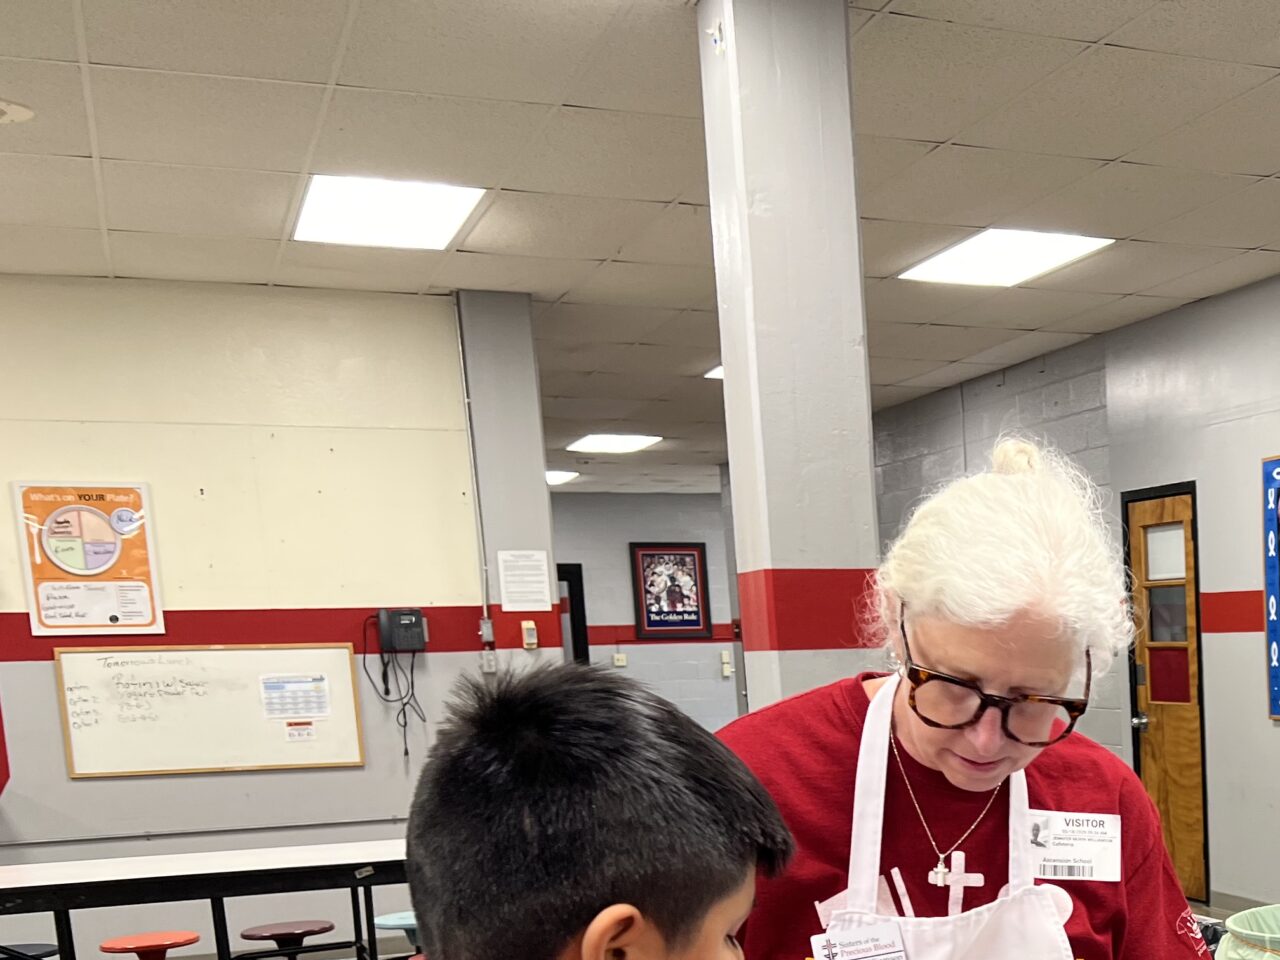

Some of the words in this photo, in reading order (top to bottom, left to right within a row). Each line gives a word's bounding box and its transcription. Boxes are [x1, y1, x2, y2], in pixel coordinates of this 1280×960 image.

[77, 493, 105, 502] YOUR
[683, 612, 698, 620] Rule
[1064, 818, 1106, 828] VISITOR
[838, 940, 862, 949] Sisters
[840, 946, 873, 958] Precious
[873, 941, 896, 952] Blood
